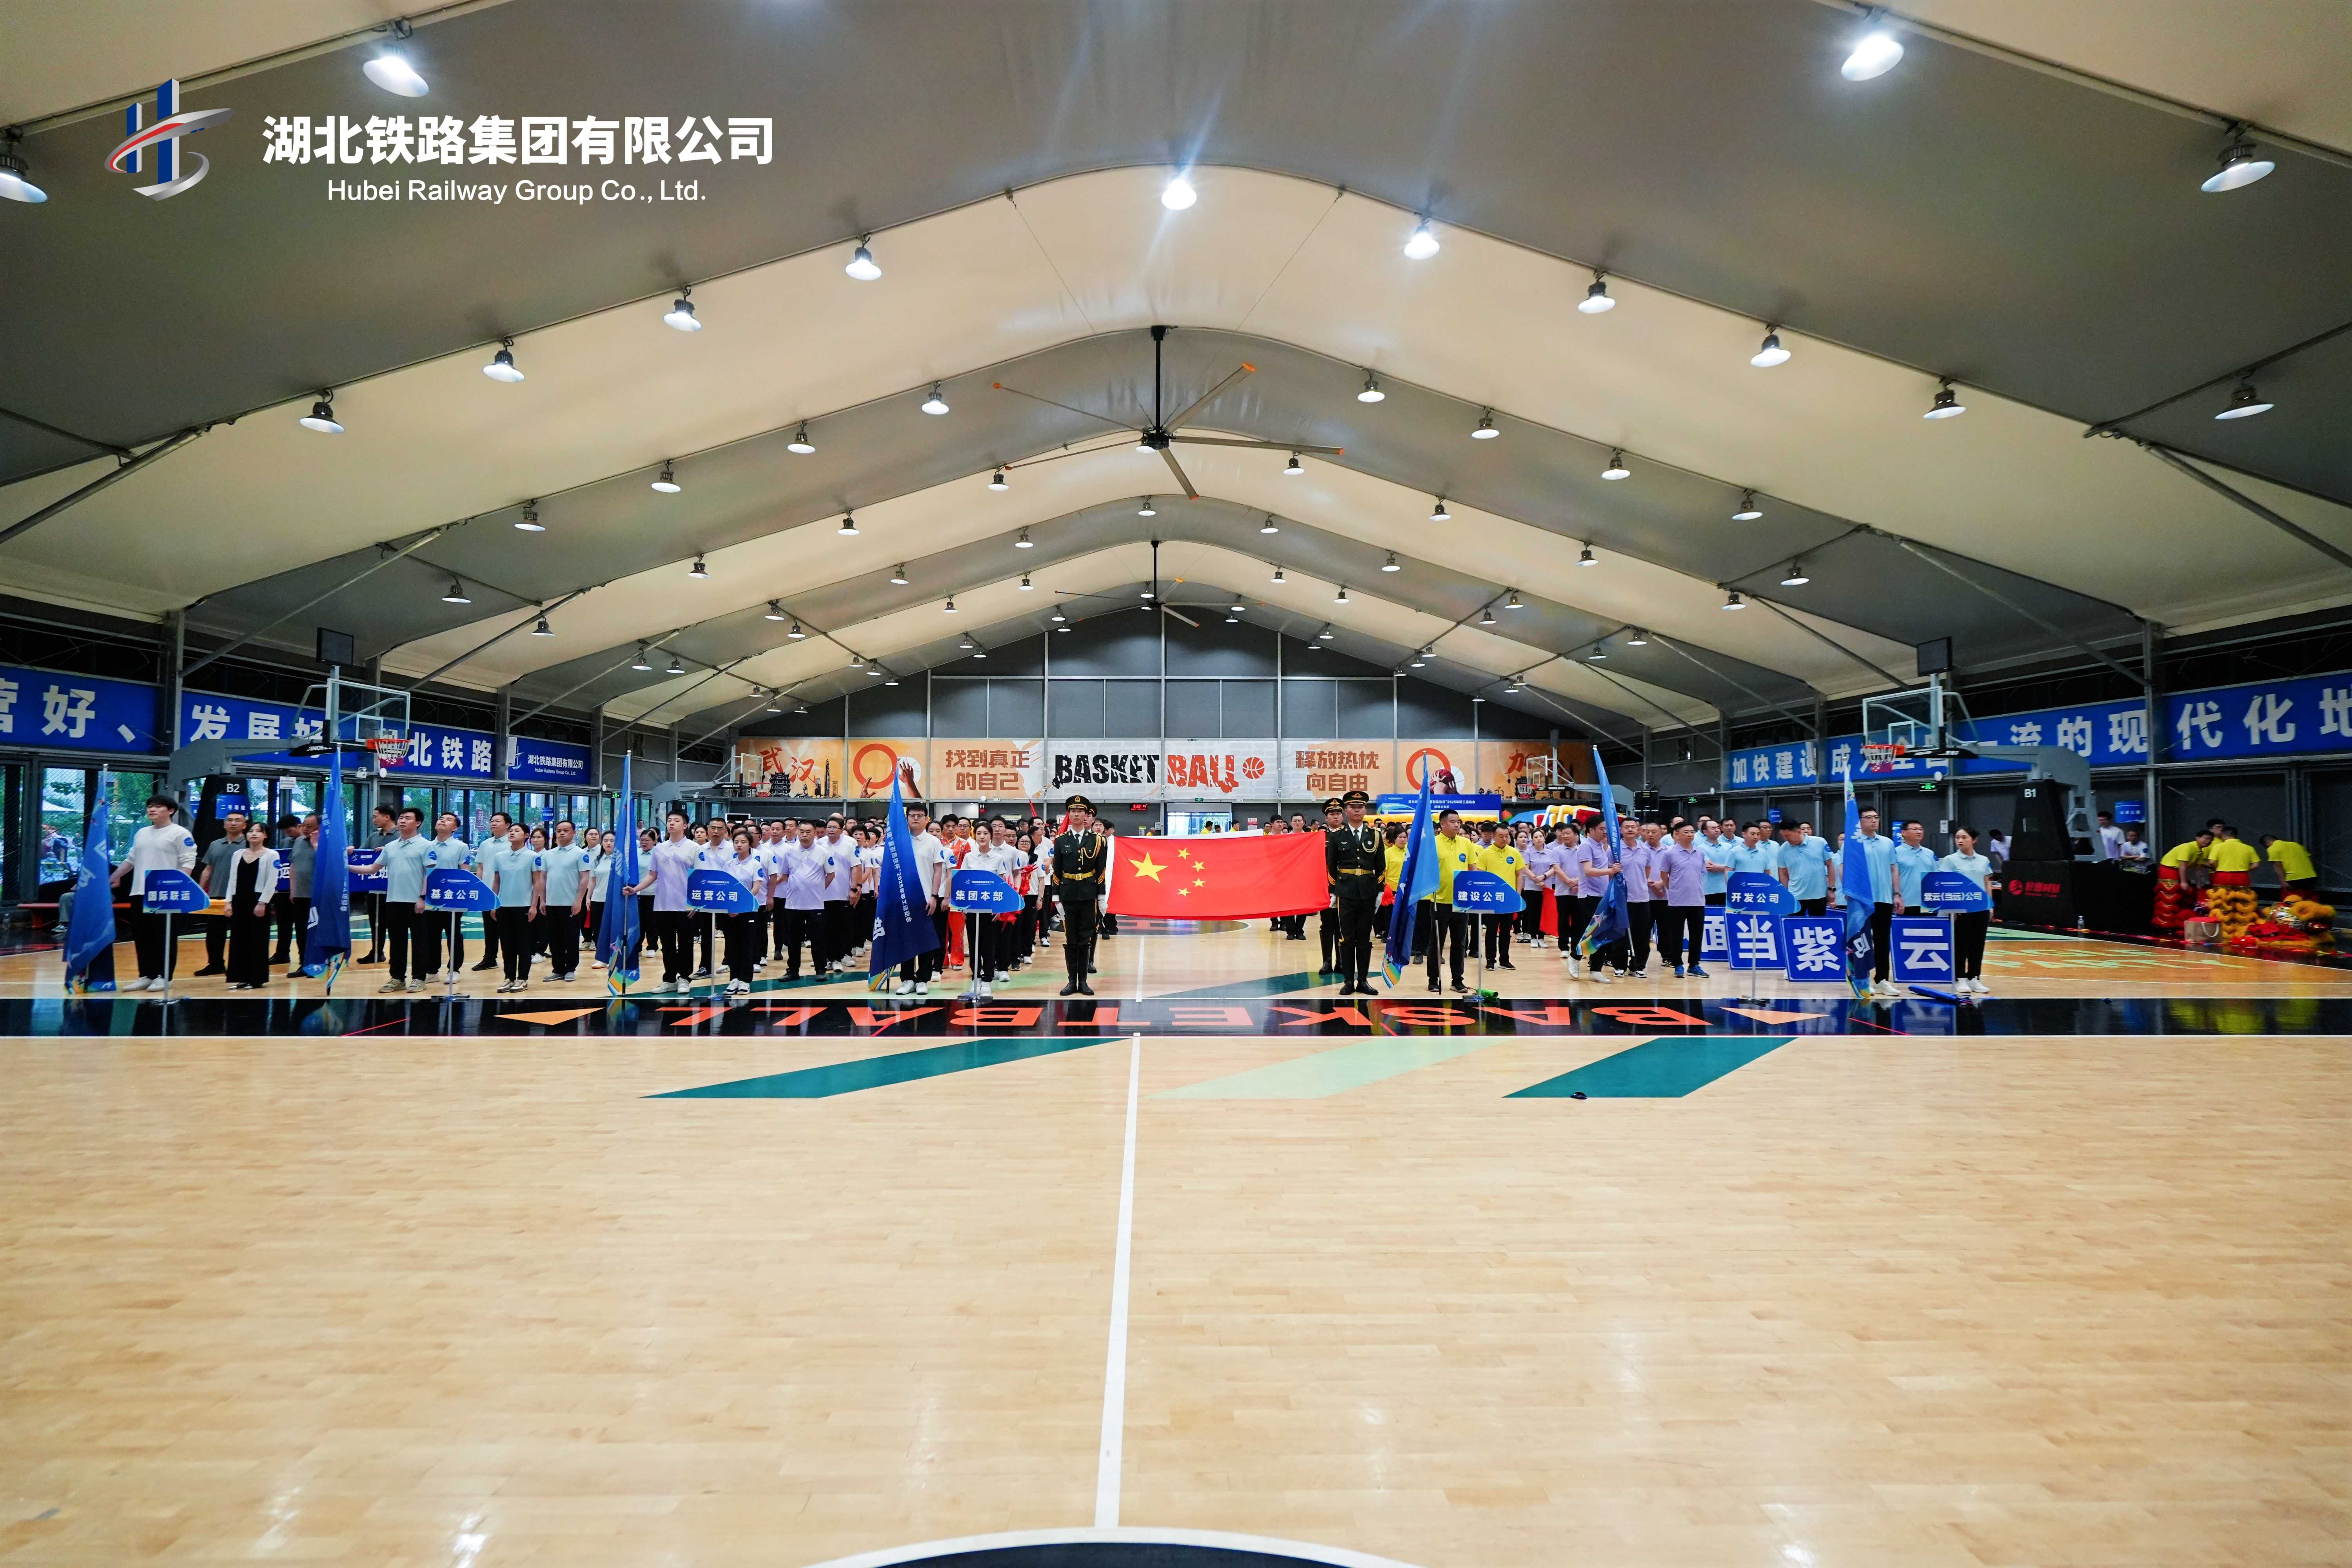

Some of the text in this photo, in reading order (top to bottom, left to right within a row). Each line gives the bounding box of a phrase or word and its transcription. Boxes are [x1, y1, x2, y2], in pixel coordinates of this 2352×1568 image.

[528, 755, 583, 769] 湖北铁路集团有限公司
[946, 750, 1029, 768] 找到真正
[1052, 754, 1239, 793] BASKET BALL
[227, 783, 240, 793] B2
[956, 772, 1019, 790] 的自己
[1307, 773, 1368, 791] 向自由
[2024, 788, 2036, 798] B1
[147, 890, 191, 902] 国际联运
[431, 889, 479, 900] 基金公司
[691, 889, 738, 902] 运营公司
[955, 890, 1003, 902] 集团本部
[1457, 891, 1505, 902] 建设公司
[1731, 892, 1779, 904] 开发公司
[1736, 918, 1778, 961] 当
[1793, 926, 1840, 972] 紫
[1900, 928, 1951, 972] 云
[652, 1006, 1713, 1026] BASKETBALL
